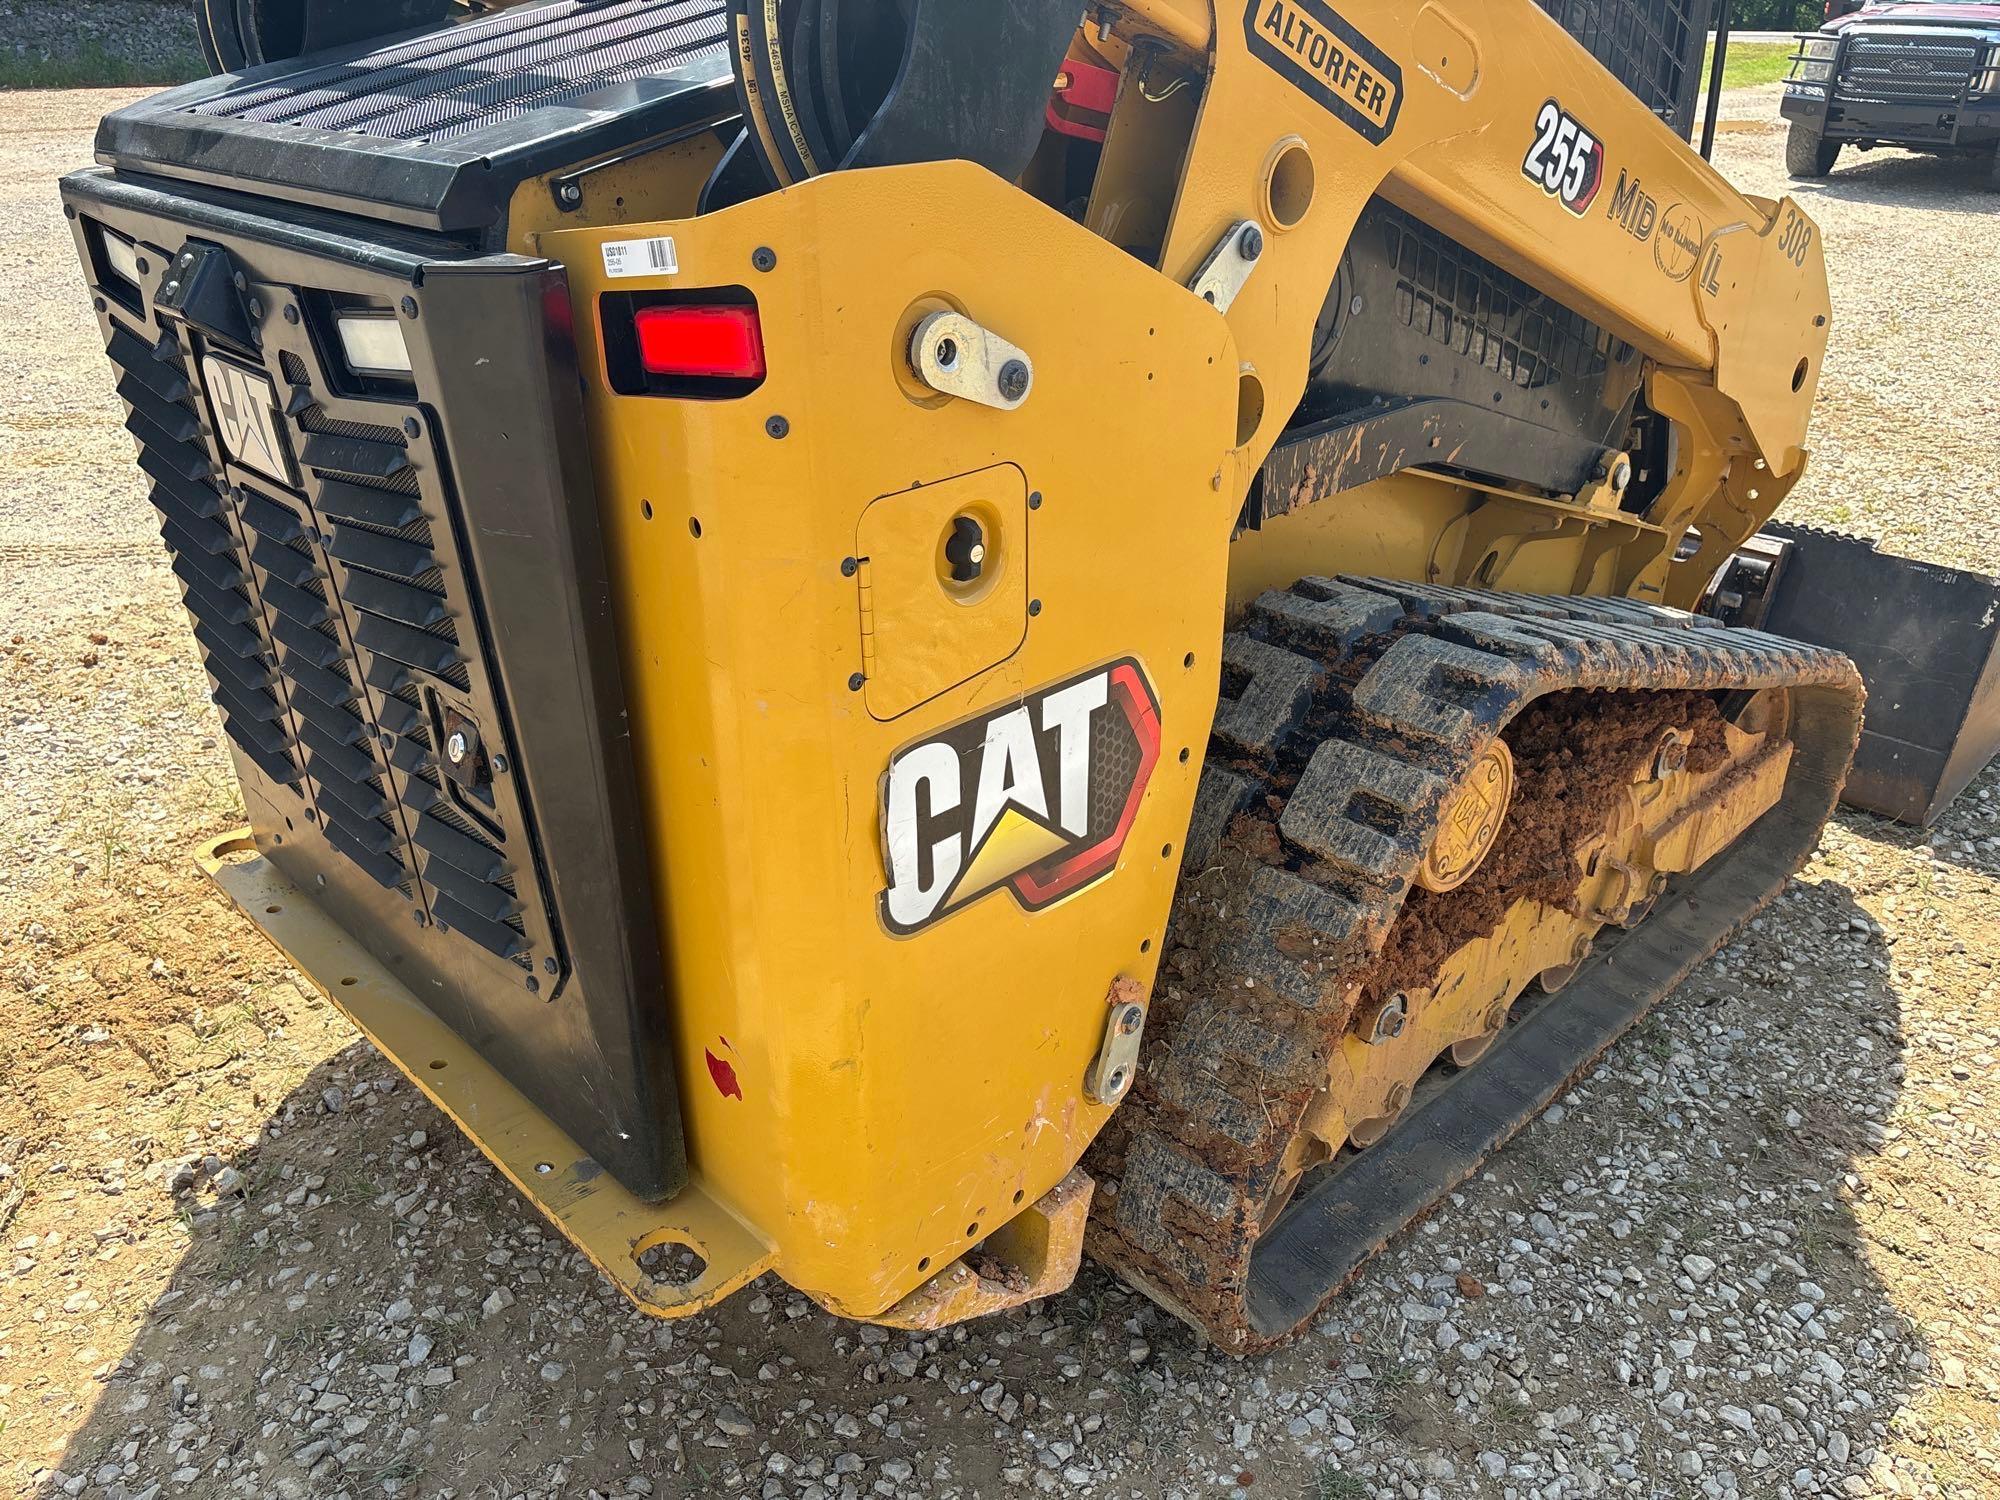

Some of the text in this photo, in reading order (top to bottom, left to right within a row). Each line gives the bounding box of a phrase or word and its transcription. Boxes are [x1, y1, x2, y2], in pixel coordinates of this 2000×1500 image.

[740, 29, 751, 62] 4636
[1263, 1, 1387, 117] ALTORFER
[780, 90, 793, 117] MSHA
[1523, 103, 1595, 202] 255
[1700, 242, 1723, 298] IL
[1778, 208, 1813, 268] 308
[202, 356, 290, 484] CAT
[886, 671, 1108, 925] CAT
